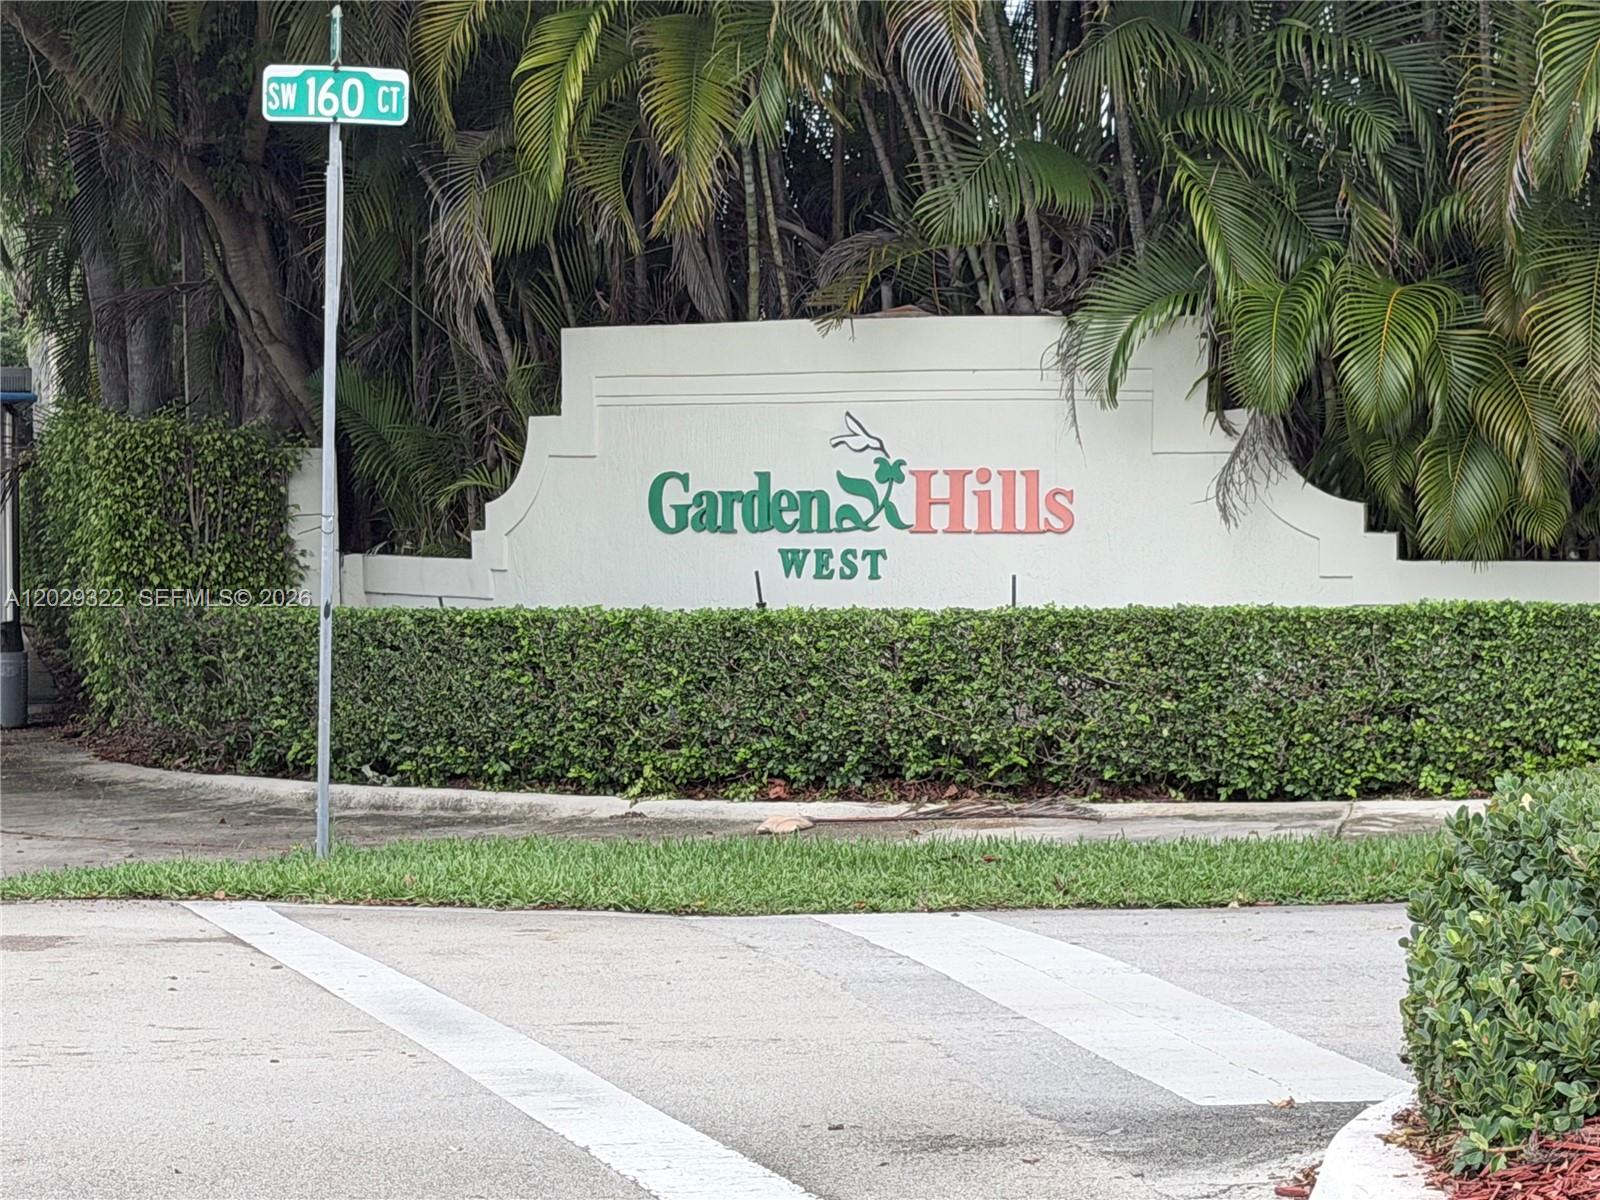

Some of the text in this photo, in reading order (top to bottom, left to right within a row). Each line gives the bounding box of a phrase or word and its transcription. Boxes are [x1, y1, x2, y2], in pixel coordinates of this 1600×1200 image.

[268, 76, 401, 118] SW 160 CT
[648, 467, 1075, 534] Garden Hills
[778, 547, 888, 580] WEST
